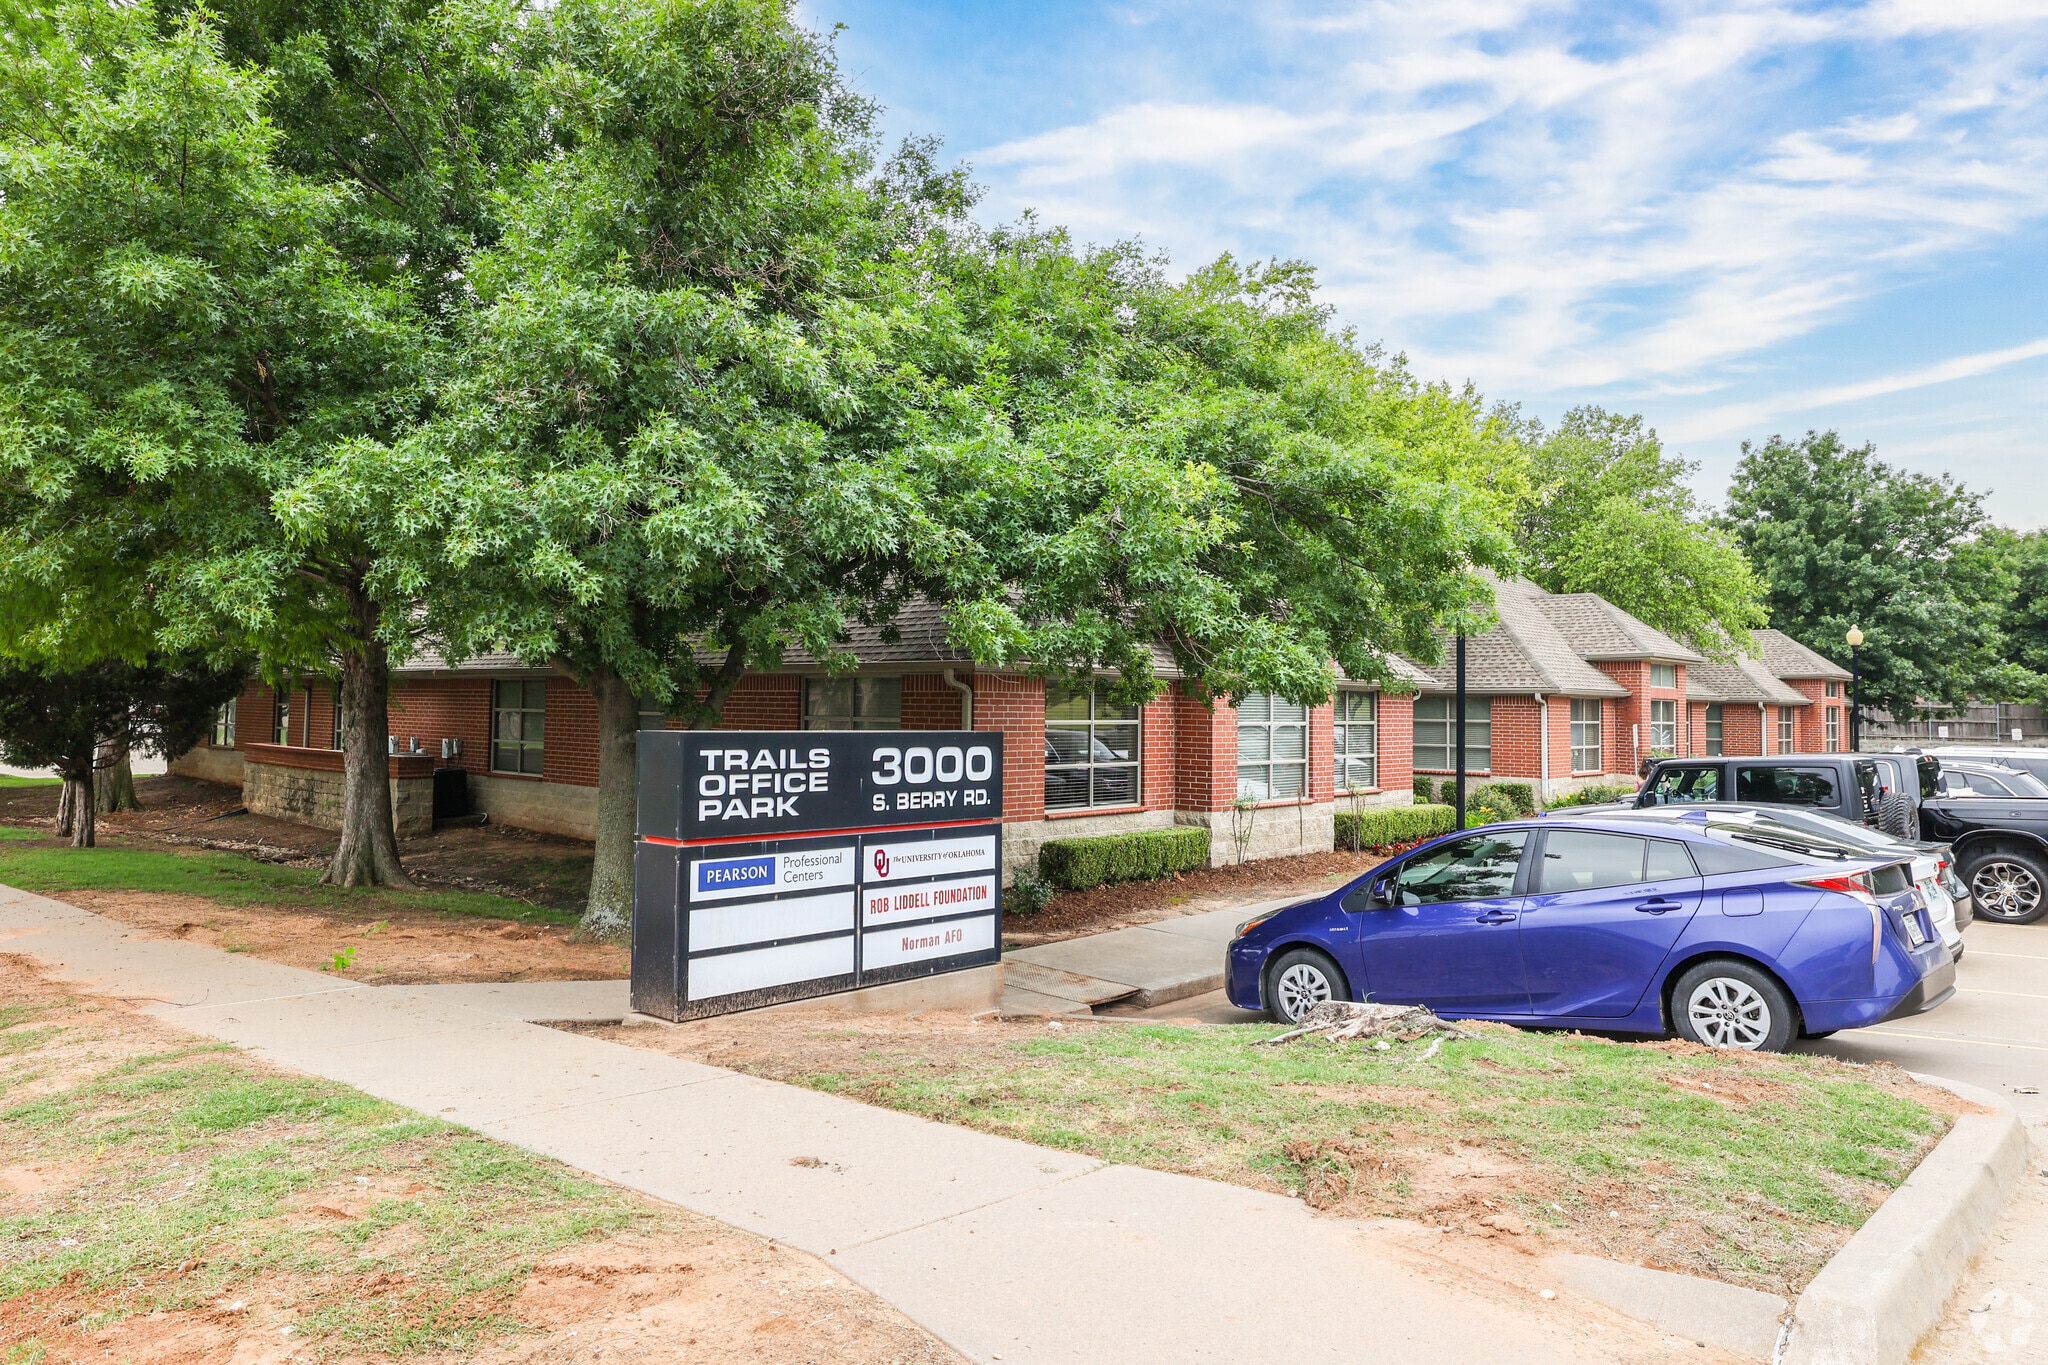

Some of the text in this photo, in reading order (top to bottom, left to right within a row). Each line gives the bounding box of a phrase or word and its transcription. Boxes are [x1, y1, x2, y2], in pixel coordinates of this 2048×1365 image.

[700, 748, 831, 771] TRAILS
[871, 746, 993, 785] 3000
[699, 771, 829, 797] OFFICE
[698, 796, 800, 821] PARK
[872, 788, 991, 812] S. BERRY RD.
[783, 852, 843, 869] Professional
[901, 852, 943, 864] UNIVERSITY
[948, 848, 985, 859] OKLAHOMA
[706, 865, 768, 884] PEARSON
[783, 870, 824, 884] Centers
[870, 885, 988, 915] ROB LIDDELL FOUNDATION
[901, 928, 963, 952] Norman AFO
